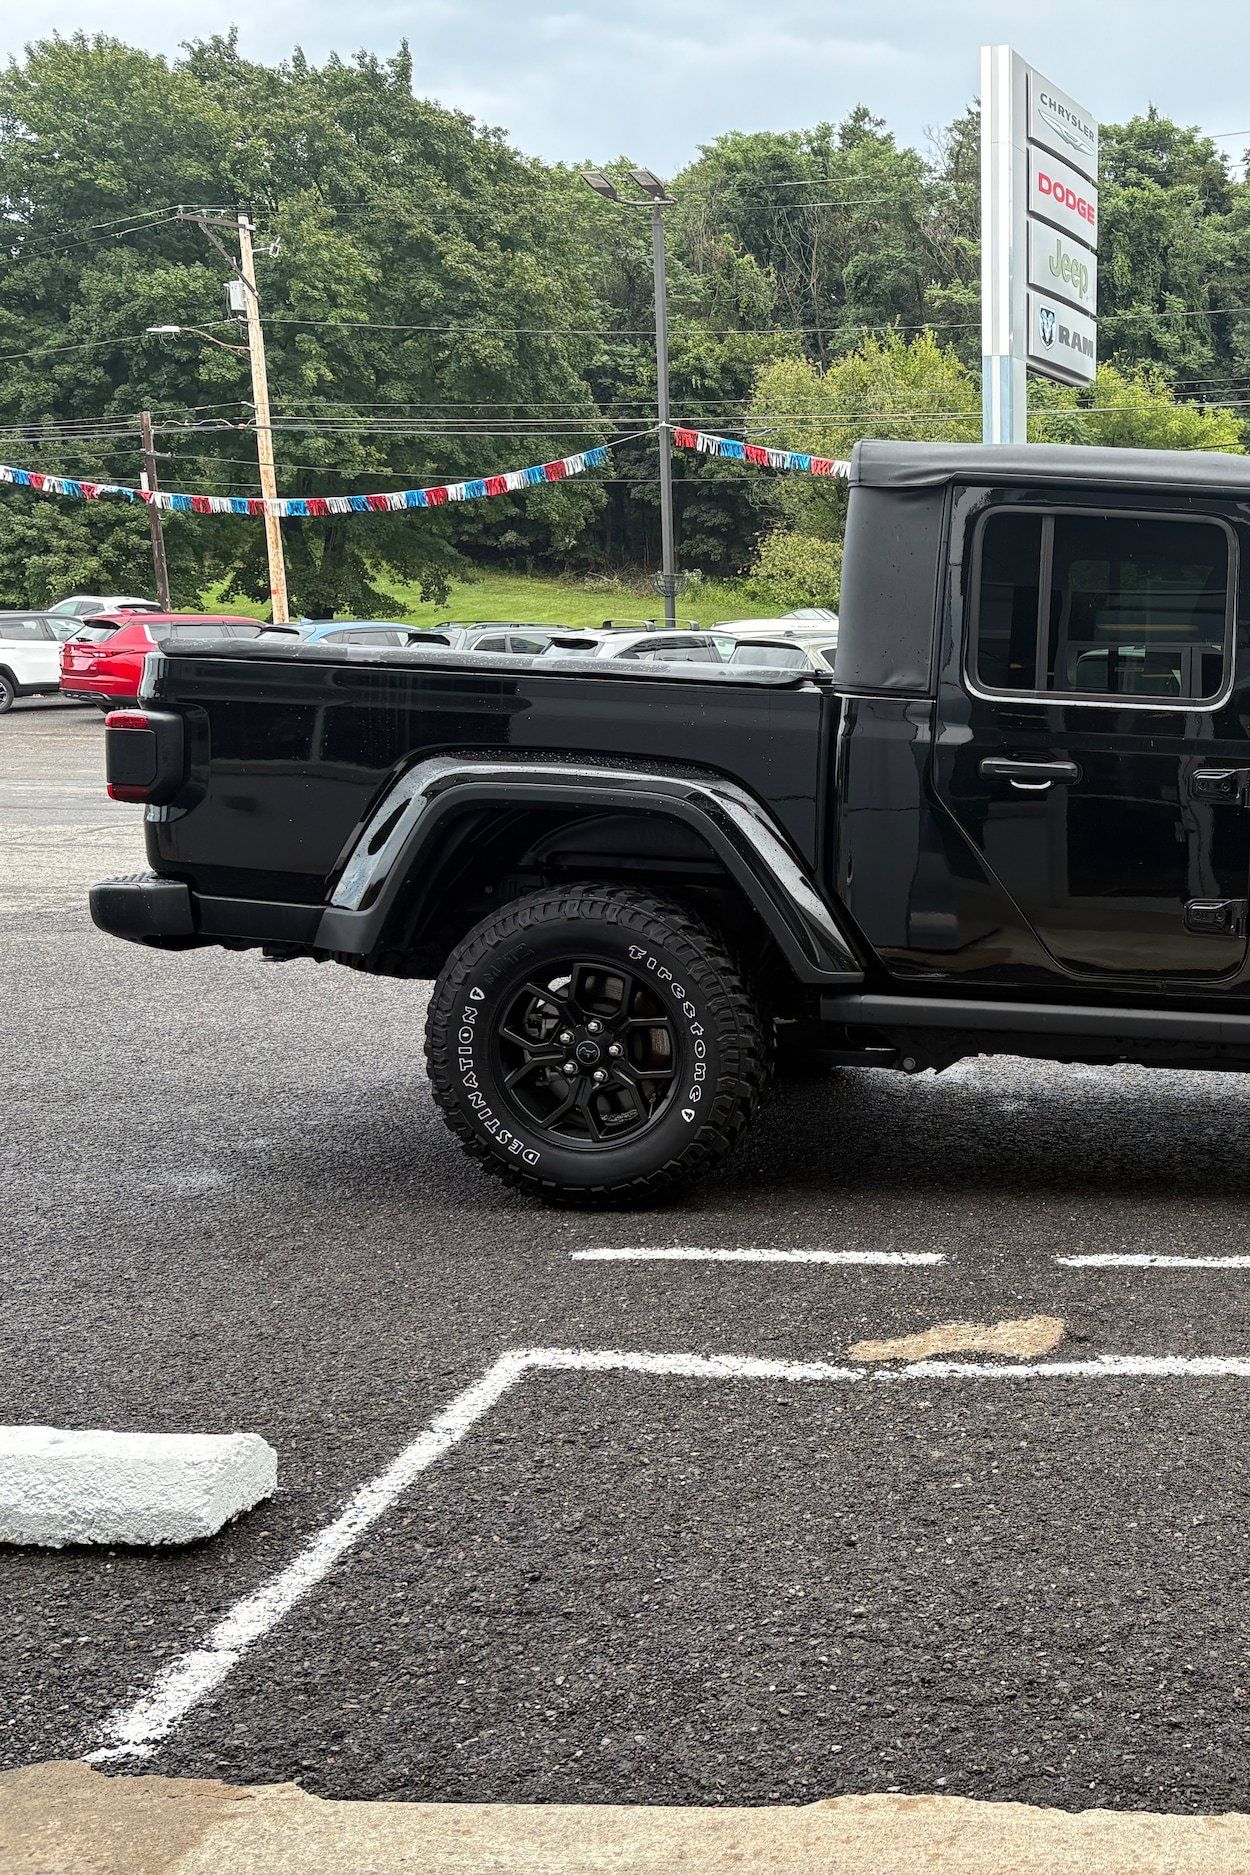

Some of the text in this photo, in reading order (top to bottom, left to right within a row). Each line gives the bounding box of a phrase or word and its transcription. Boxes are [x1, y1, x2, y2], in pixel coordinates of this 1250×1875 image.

[1040, 92, 1095, 142] CHRYSLER
[1038, 172, 1095, 226] DODGE
[1049, 239, 1088, 299] Jeep
[1059, 324, 1094, 358] RAM
[458, 1006, 541, 1166] DESTINATION
